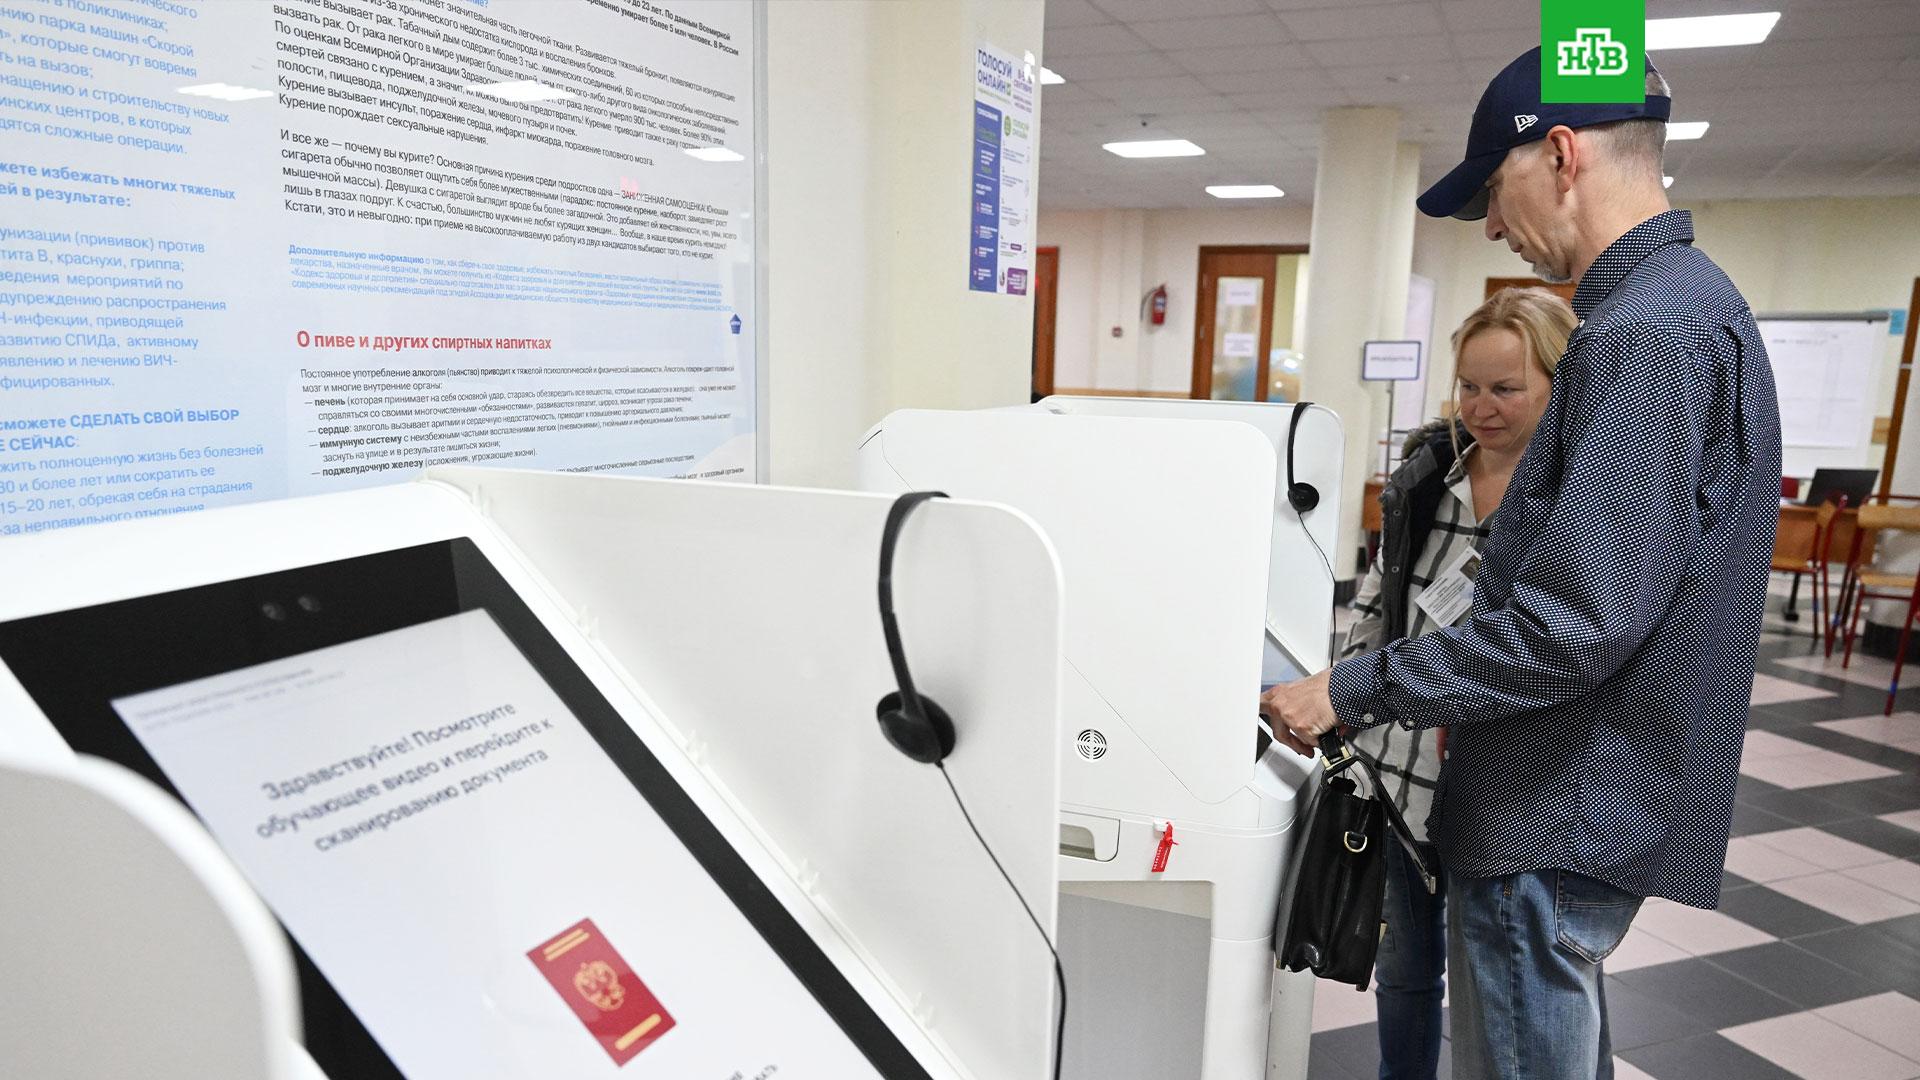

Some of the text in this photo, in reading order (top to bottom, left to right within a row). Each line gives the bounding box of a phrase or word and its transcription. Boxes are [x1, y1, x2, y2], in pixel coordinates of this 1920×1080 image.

[322, 0, 374, 21] вызывает
[0, 6, 194, 57] нию парка машин «Скорой
[273, 4, 321, 24] вызвать
[346, 20, 361, 34] От
[362, 27, 386, 41] рака
[387, 33, 424, 51] легкого
[275, 19, 401, 62] По оценкам Всемирной
[16, 54, 37, 68] на
[20, 32, 89, 55] которые
[91, 46, 141, 67] смогут
[143, 56, 197, 78] вовремя
[276, 40, 325, 60] смертей
[326, 52, 370, 71] связано
[371, 63, 378, 73] с
[977, 49, 1012, 78] ГОЛОСУЙ
[278, 74, 326, 96] Курение
[327, 87, 378, 106] вызывает
[977, 69, 1006, 95] ОНЛАЙН
[0, 73, 229, 123] нащению и строительству новых
[127, 115, 137, 126] в
[139, 117, 191, 135] которых
[279, 92, 326, 113] Курение
[328, 104, 385, 123] порождает
[386, 116, 445, 136] сексуальные
[44, 124, 114, 144] сложные
[280, 128, 435, 165] И все же почему вы курите?
[281, 148, 424, 179] сигарета обычно позволяет
[21, 186, 32, 197] в
[40, 165, 120, 186] избежать
[122, 176, 177, 192] многих
[179, 183, 235, 199] тяжелых
[282, 166, 341, 183] мышечной
[384, 178, 428, 198] Девушка
[283, 183, 358, 202] лишь в глазах
[327, 206, 346, 217] это
[347, 208, 355, 218] и
[0, 227, 205, 253] унизации (прививок) против
[1, 248, 34, 262] тита
[66, 274, 163, 289] мероприятий
[165, 279, 183, 290] по
[0, 292, 226, 312] дупреждению распространения
[96, 316, 184, 330] приводящей
[126, 336, 198, 353] активному
[297, 330, 551, 352] О пиве и других спиртных напитках
[0, 351, 177, 368] явлению и лечению ВИЧ-
[69, 412, 141, 429] СДЕЛАТЬ
[143, 408, 184, 424] СВОЙ
[186, 409, 240, 422] ВЫБОР
[0, 443, 264, 473] жить полноценную жизнь без болезней
[18, 482, 29, 492] и
[31, 477, 76, 491] более
[79, 475, 103, 487] лет
[105, 473, 132, 485] или
[134, 468, 199, 485] сократить
[199, 465, 216, 477] ее
[1, 497, 45, 514] 15–20
[78, 491, 135, 508] обрекая
[136, 486, 169, 502] себя
[171, 487, 186, 498] на
[188, 480, 253, 497] страдания
[261, 703, 516, 801] Здравствуйте! Посмотрите
[257, 718, 554, 838] обучающее видео и перейдите к
[314, 748, 549, 852] сканированию документа
